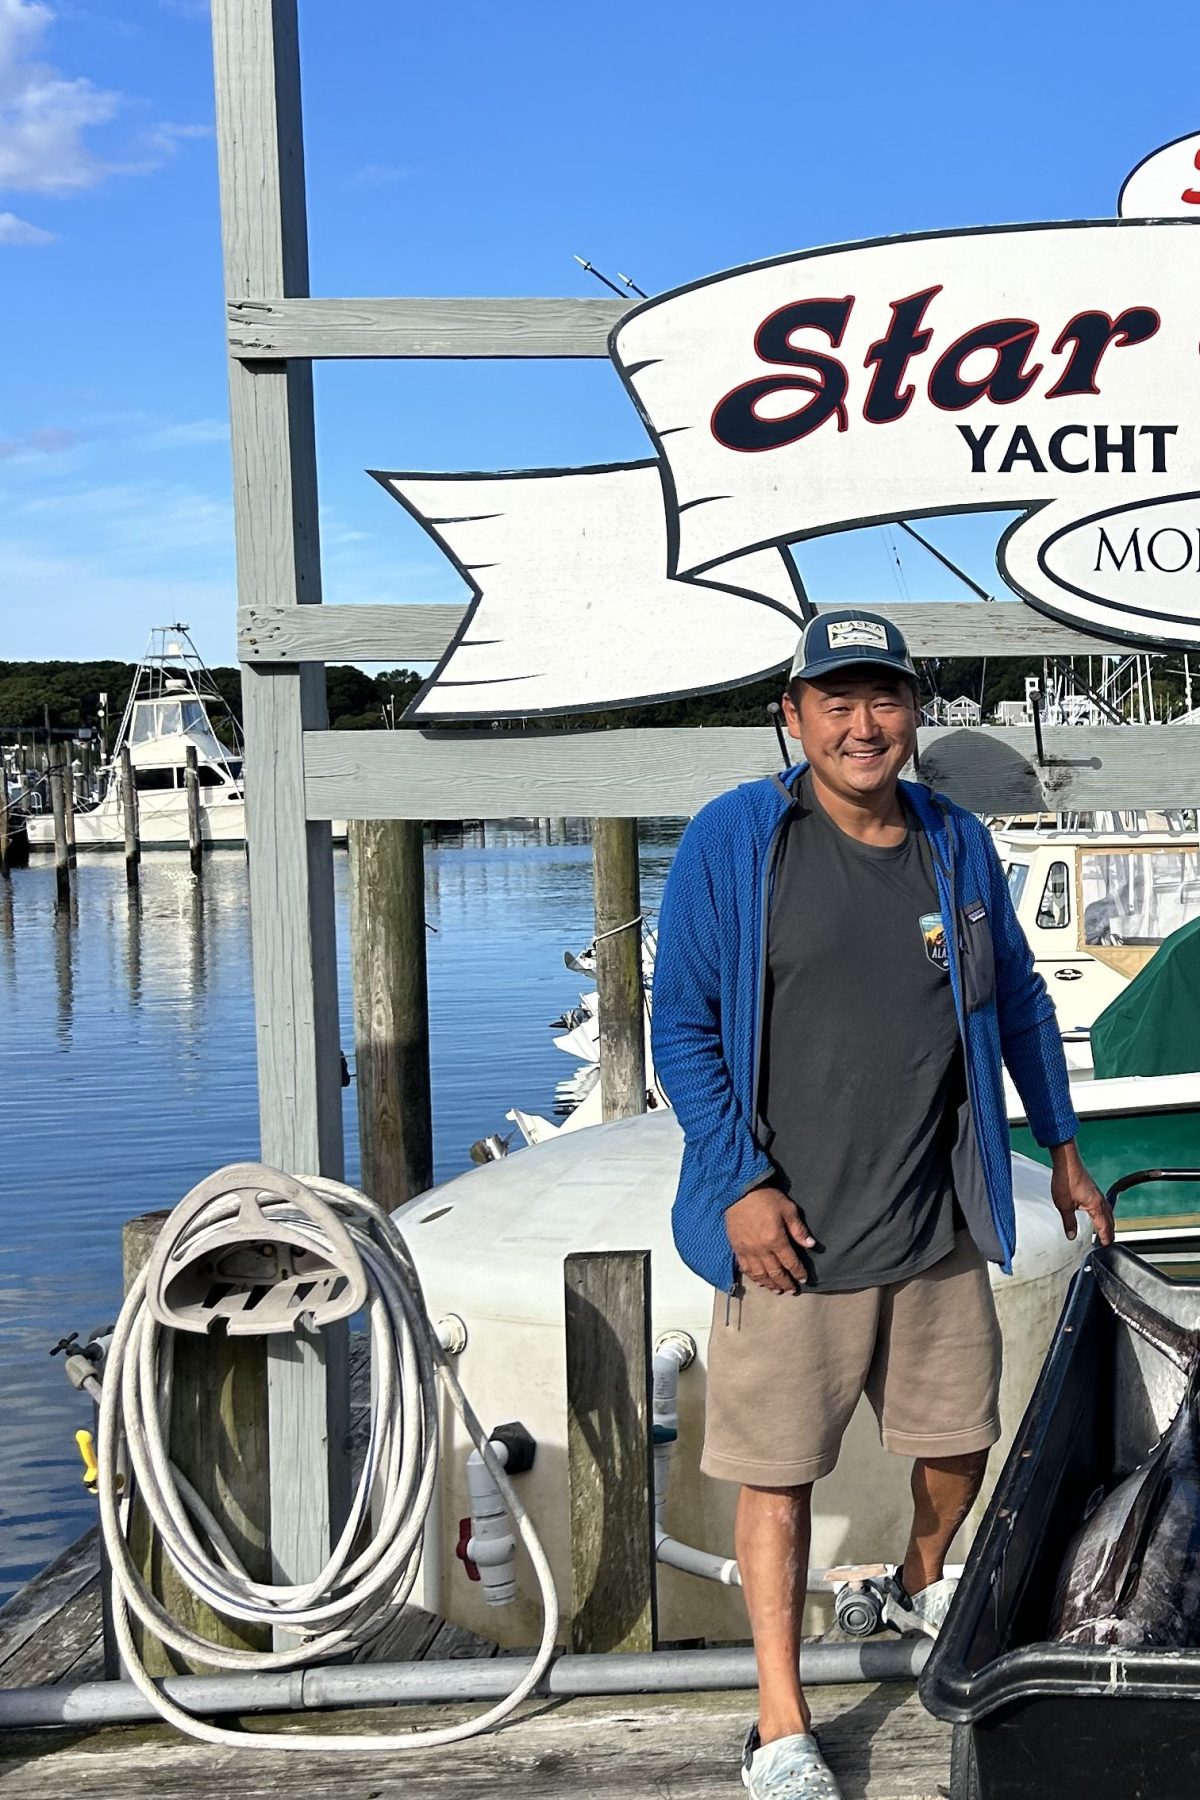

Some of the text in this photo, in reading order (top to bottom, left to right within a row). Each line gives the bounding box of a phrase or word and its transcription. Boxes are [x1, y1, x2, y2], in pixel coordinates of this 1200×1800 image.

[711, 284, 1161, 453] Star
[957, 424, 1178, 474] YACHT
[832, 622, 882, 632] ALASKA
[931, 946, 947, 959] ALA
